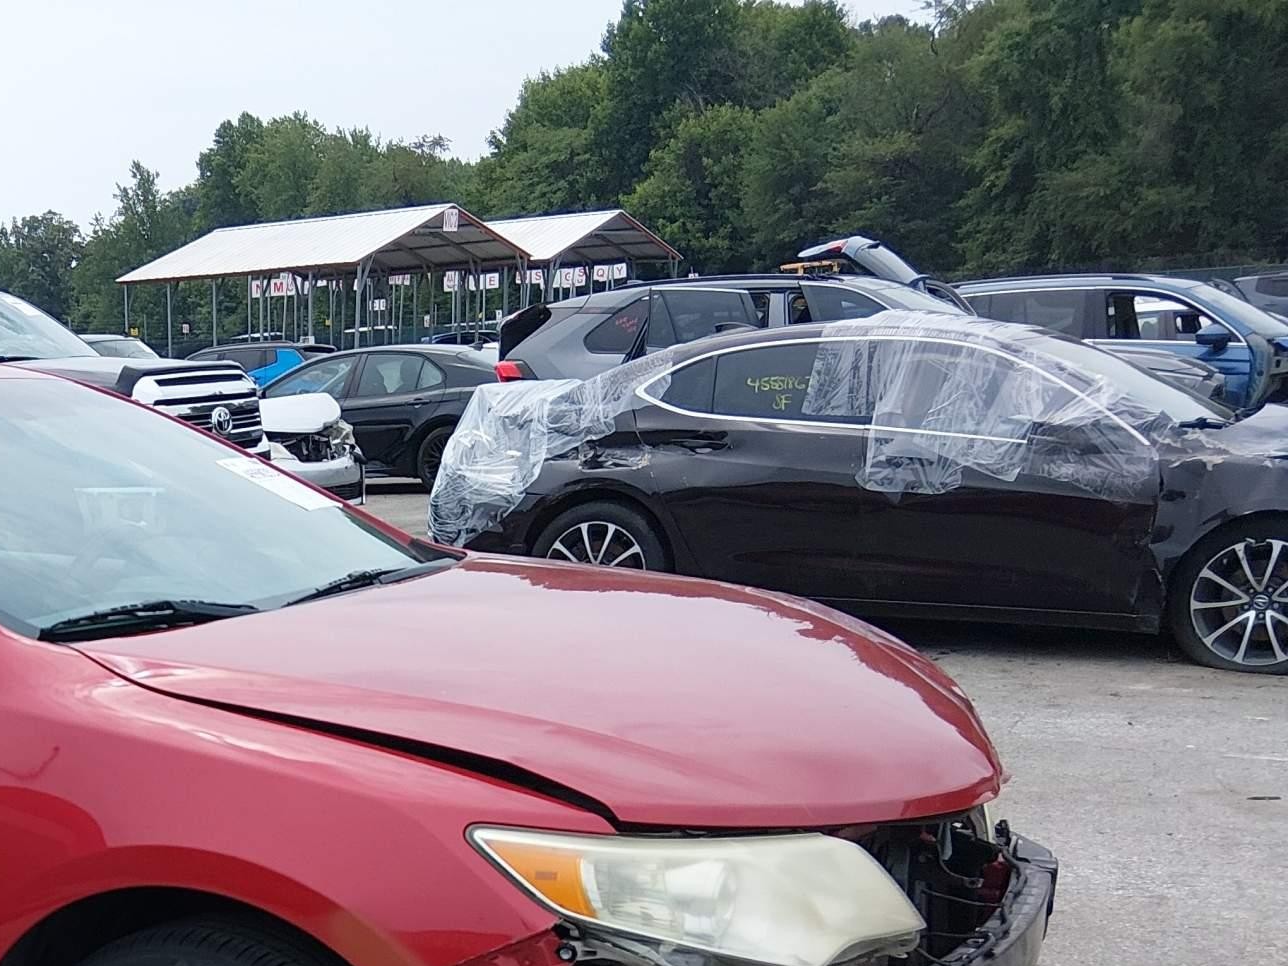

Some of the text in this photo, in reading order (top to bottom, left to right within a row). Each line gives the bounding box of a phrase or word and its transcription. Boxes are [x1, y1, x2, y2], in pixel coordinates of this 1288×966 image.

[535, 271, 542, 281] S
[596, 268, 605, 278] Q
[615, 266, 624, 276] Y
[487, 276, 496, 286] E
[273, 282, 284, 293] M
